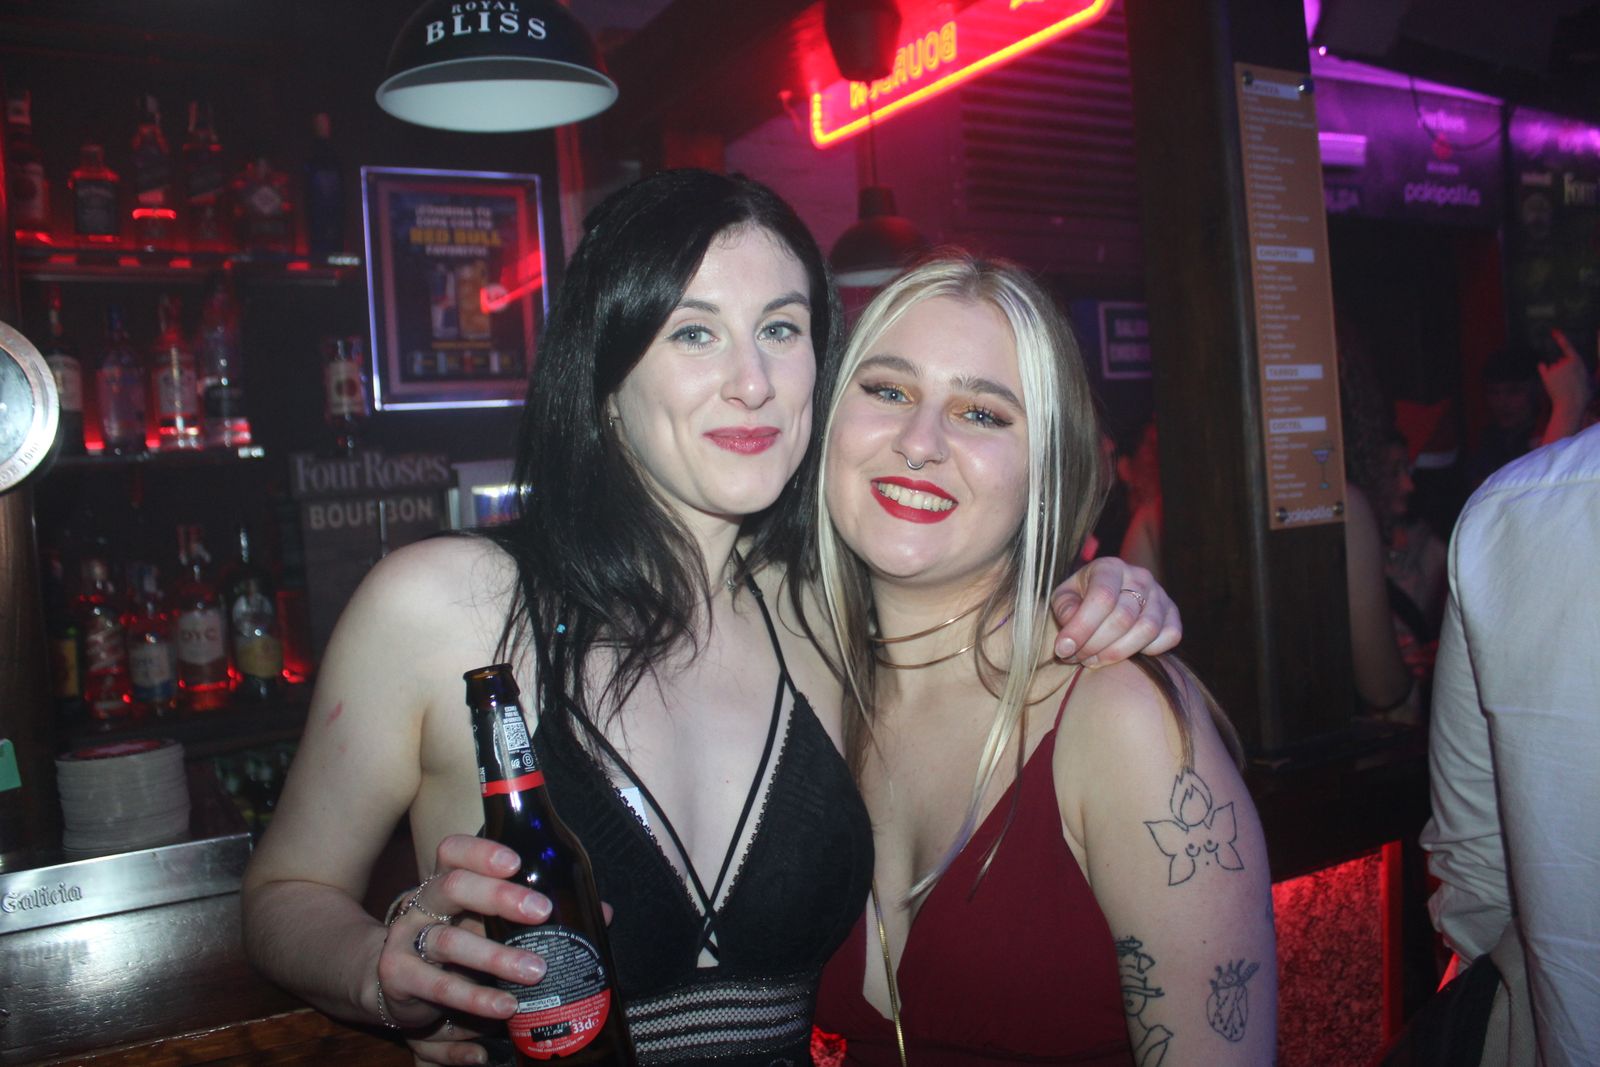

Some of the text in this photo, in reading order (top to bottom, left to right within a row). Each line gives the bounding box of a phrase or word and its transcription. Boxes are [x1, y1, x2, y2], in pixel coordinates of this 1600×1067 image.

[451, 0, 520, 15] ROYAL
[426, 11, 547, 45] BLISS
[1, 881, 83, 913] Galicia
